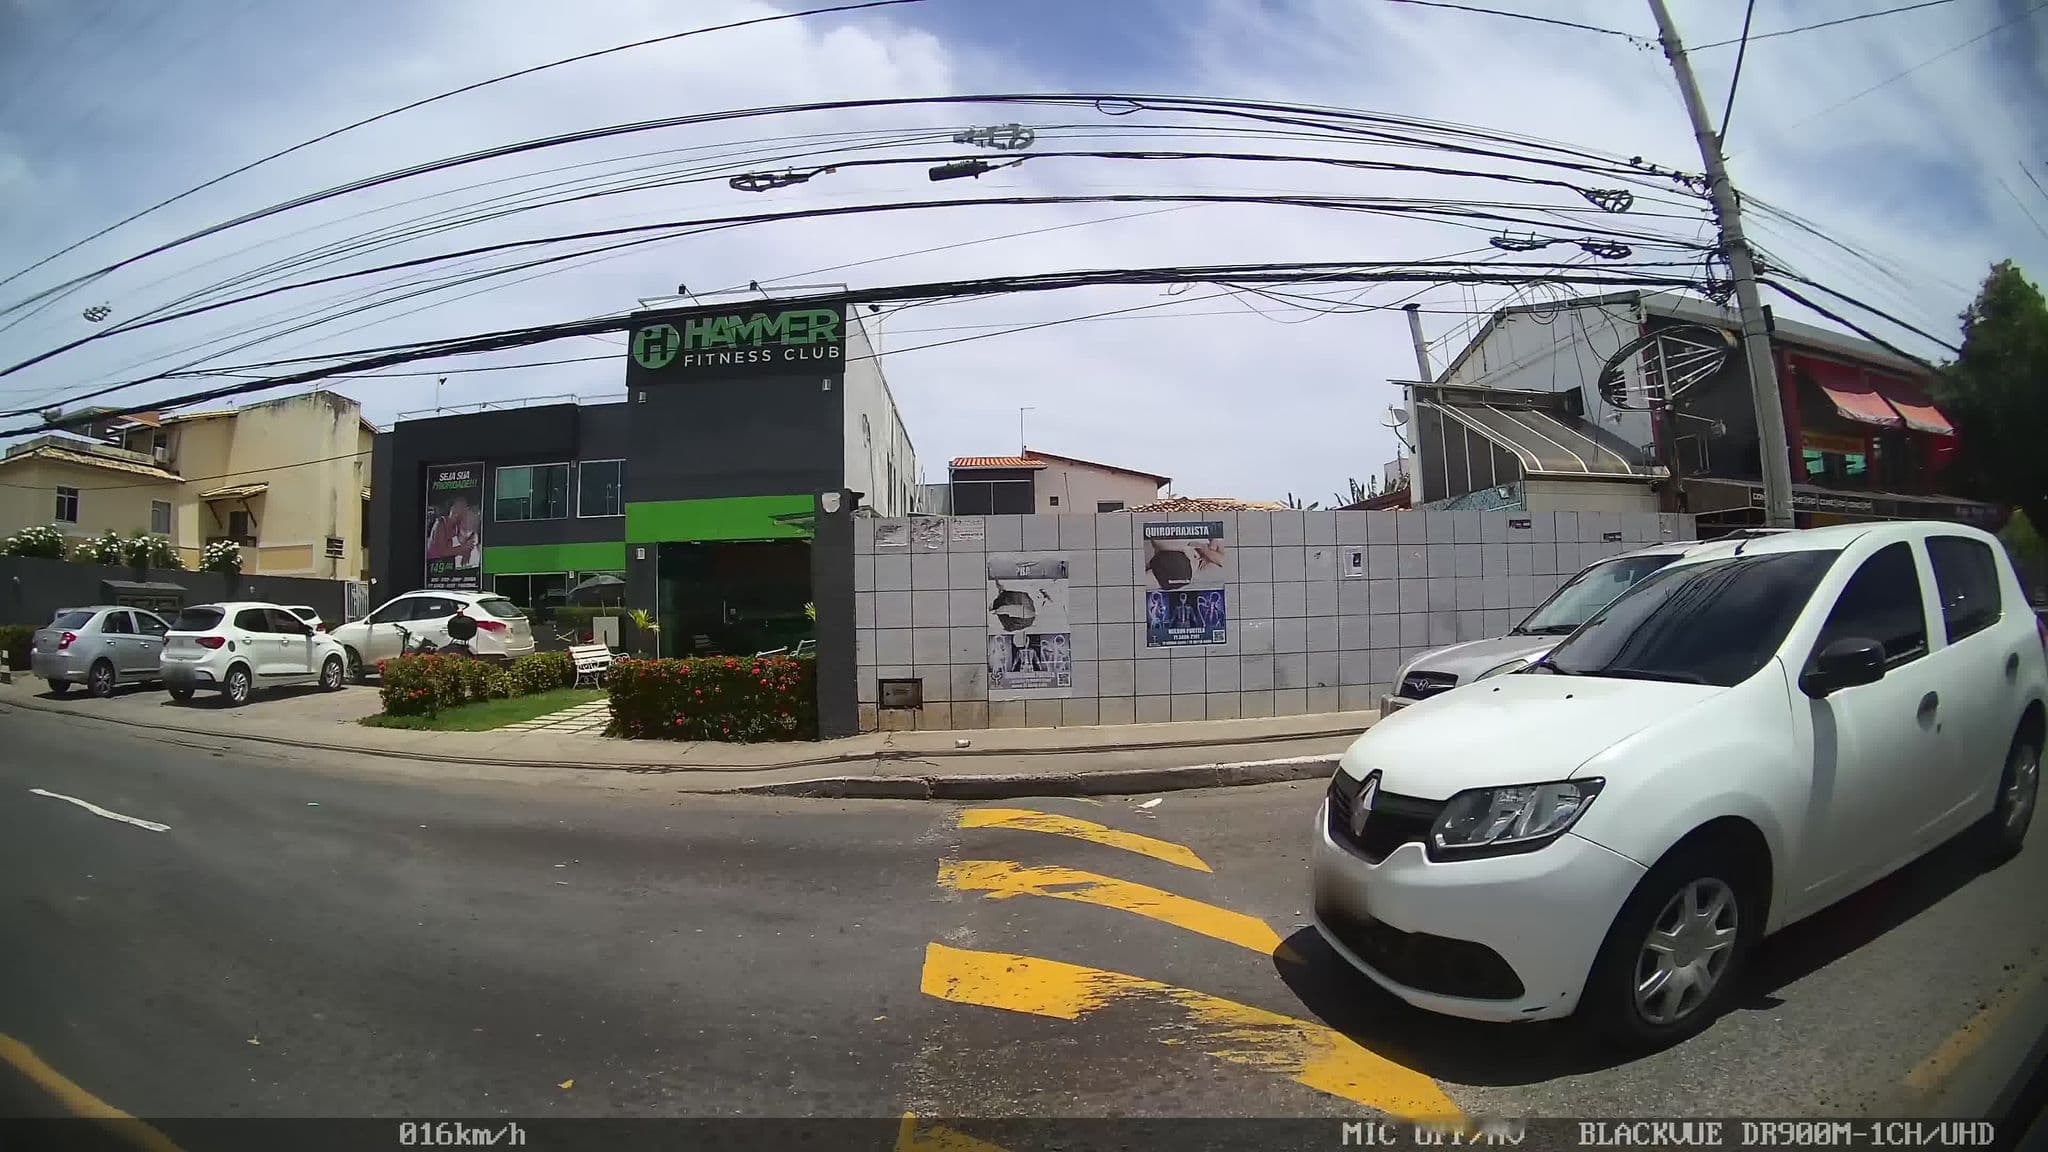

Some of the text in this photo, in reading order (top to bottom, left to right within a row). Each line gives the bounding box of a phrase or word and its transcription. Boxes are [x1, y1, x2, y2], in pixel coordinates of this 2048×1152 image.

[684, 309, 840, 349] HAMMER
[684, 346, 840, 367] FITNESS CLUB
[440, 470, 470, 482] SEJA SUA
[1145, 526, 1210, 538] QUIROPRAXISTA
